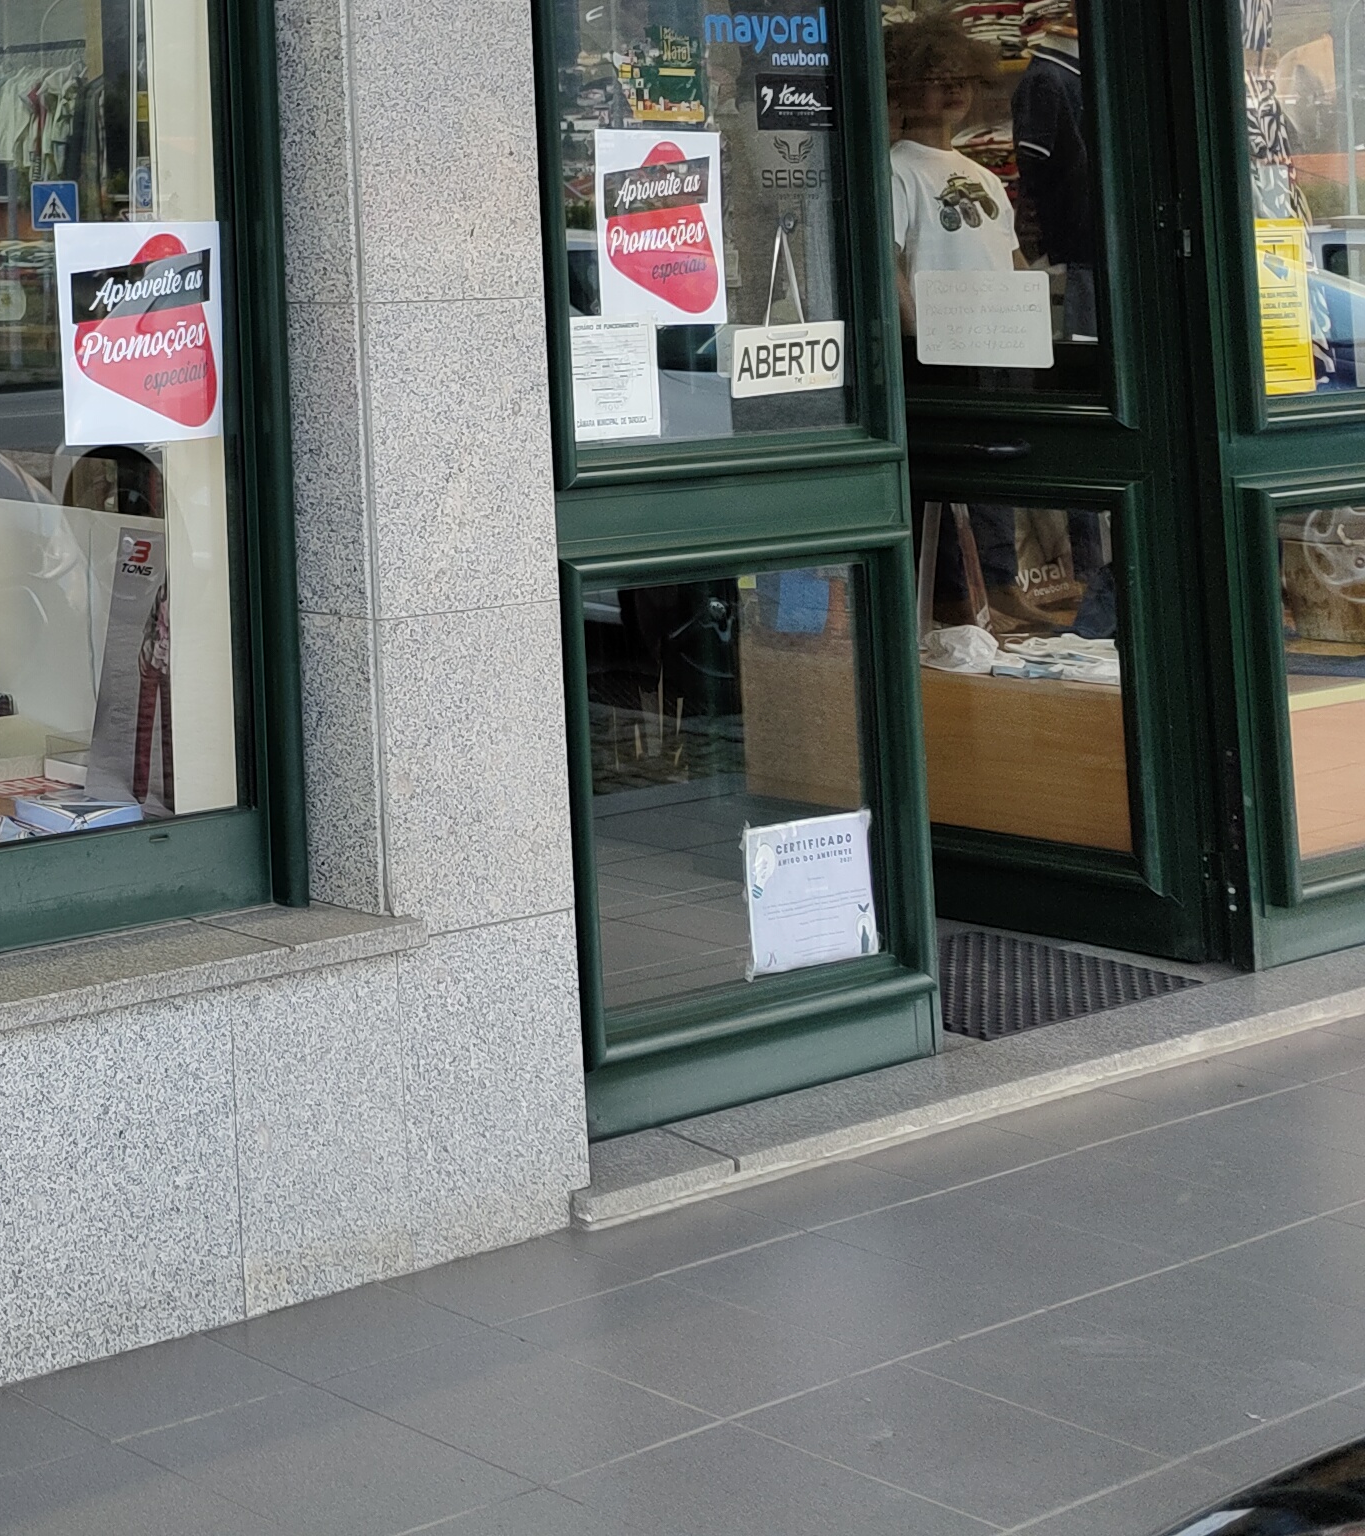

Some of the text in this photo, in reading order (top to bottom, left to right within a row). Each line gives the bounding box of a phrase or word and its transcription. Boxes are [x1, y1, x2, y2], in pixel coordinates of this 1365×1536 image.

[704, 7, 828, 53] mayoral
[771, 49, 829, 66] newborn
[614, 171, 702, 209] Aproveite as
[610, 219, 706, 257] Promoções
[651, 255, 707, 283] especiais
[89, 267, 204, 312] Aproveite as
[82, 321, 206, 366] Promoções
[737, 338, 840, 382] ABERTO
[143, 357, 208, 396] especiais
[121, 563, 153, 577] TONS
[128, 540, 152, 564] 3
[776, 833, 852, 855] CERTIFICADO
[778, 848, 853, 866] AMIGO DO AMBIENTE
